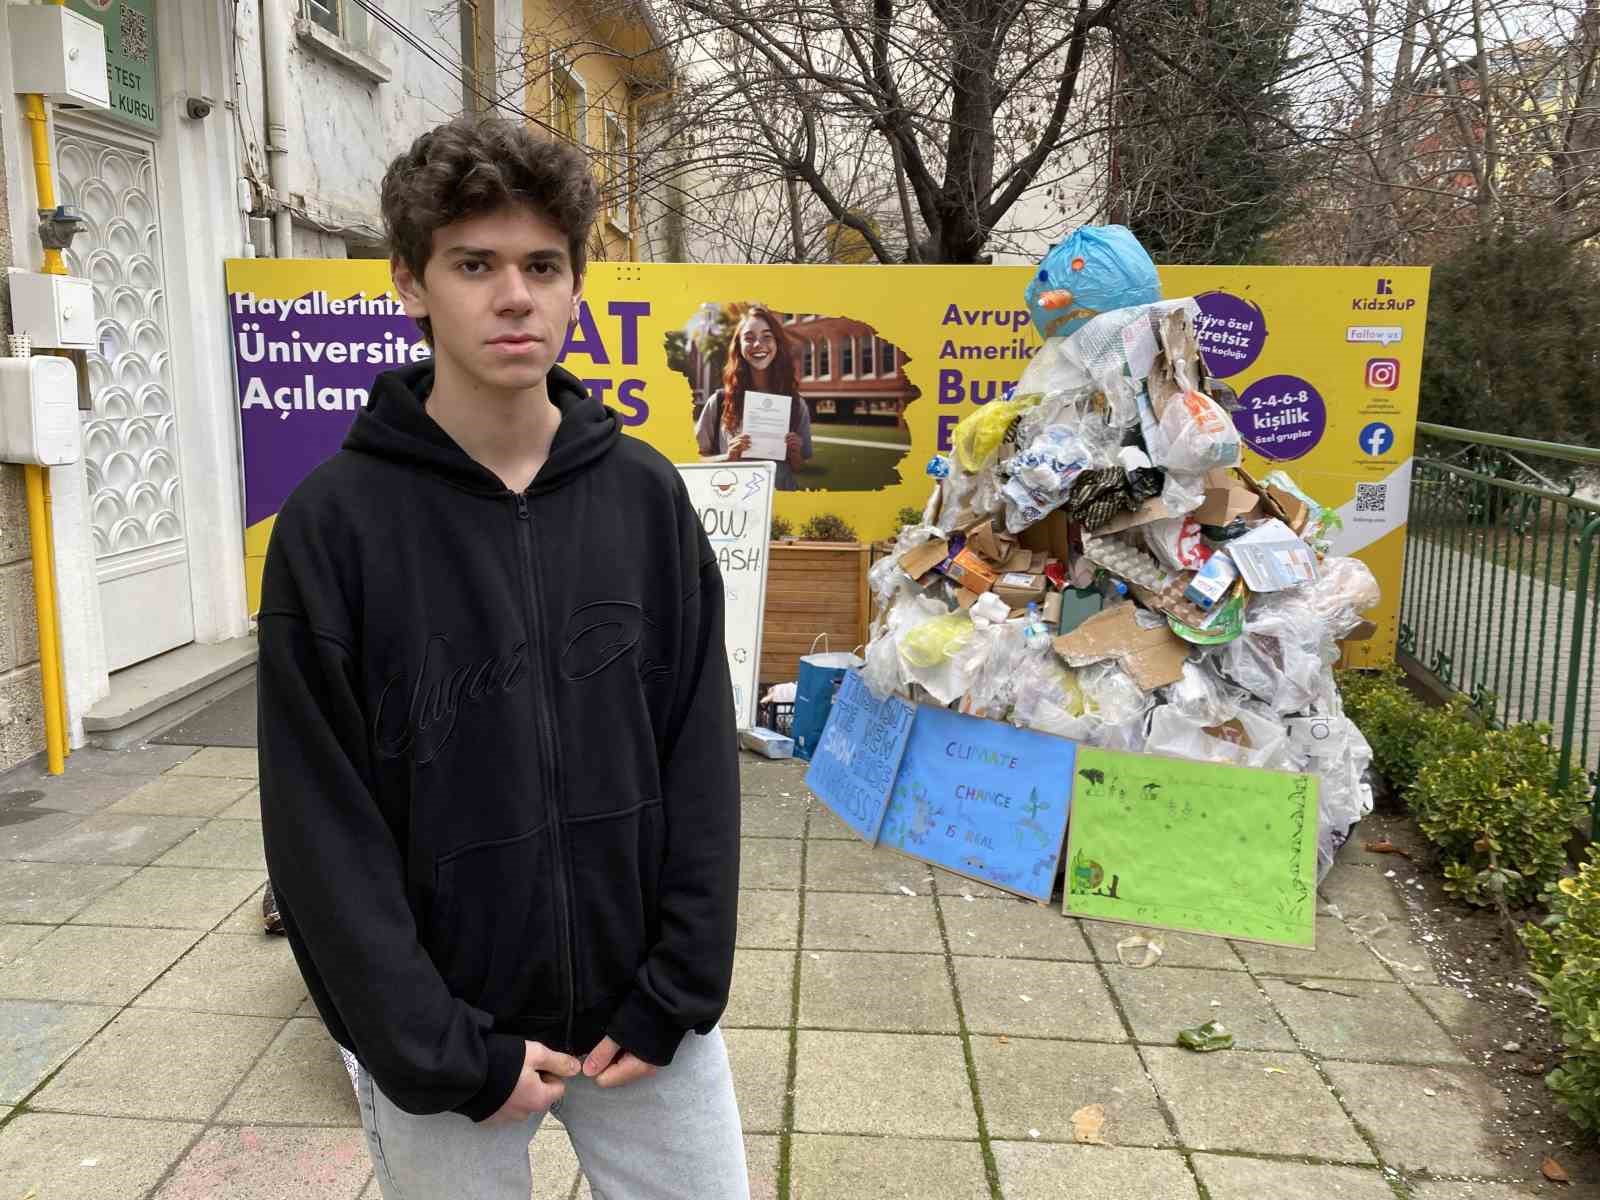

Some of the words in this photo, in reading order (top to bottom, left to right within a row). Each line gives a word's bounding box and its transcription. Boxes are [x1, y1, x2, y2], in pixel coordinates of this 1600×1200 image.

[114, 66, 142, 91] TEST
[119, 94, 154, 122] KURSU
[1227, 317, 1254, 331] özel
[239, 322, 433, 364] Üniversite
[242, 374, 369, 420] Açılan
[1251, 390, 1309, 410] 2-4-6-8
[1253, 407, 1310, 431] kişilik
[1255, 433, 1275, 444] özel
[1276, 430, 1312, 443] gruplar
[945, 741, 1018, 769] CLIMATE
[955, 784, 1012, 809] CHANGE
